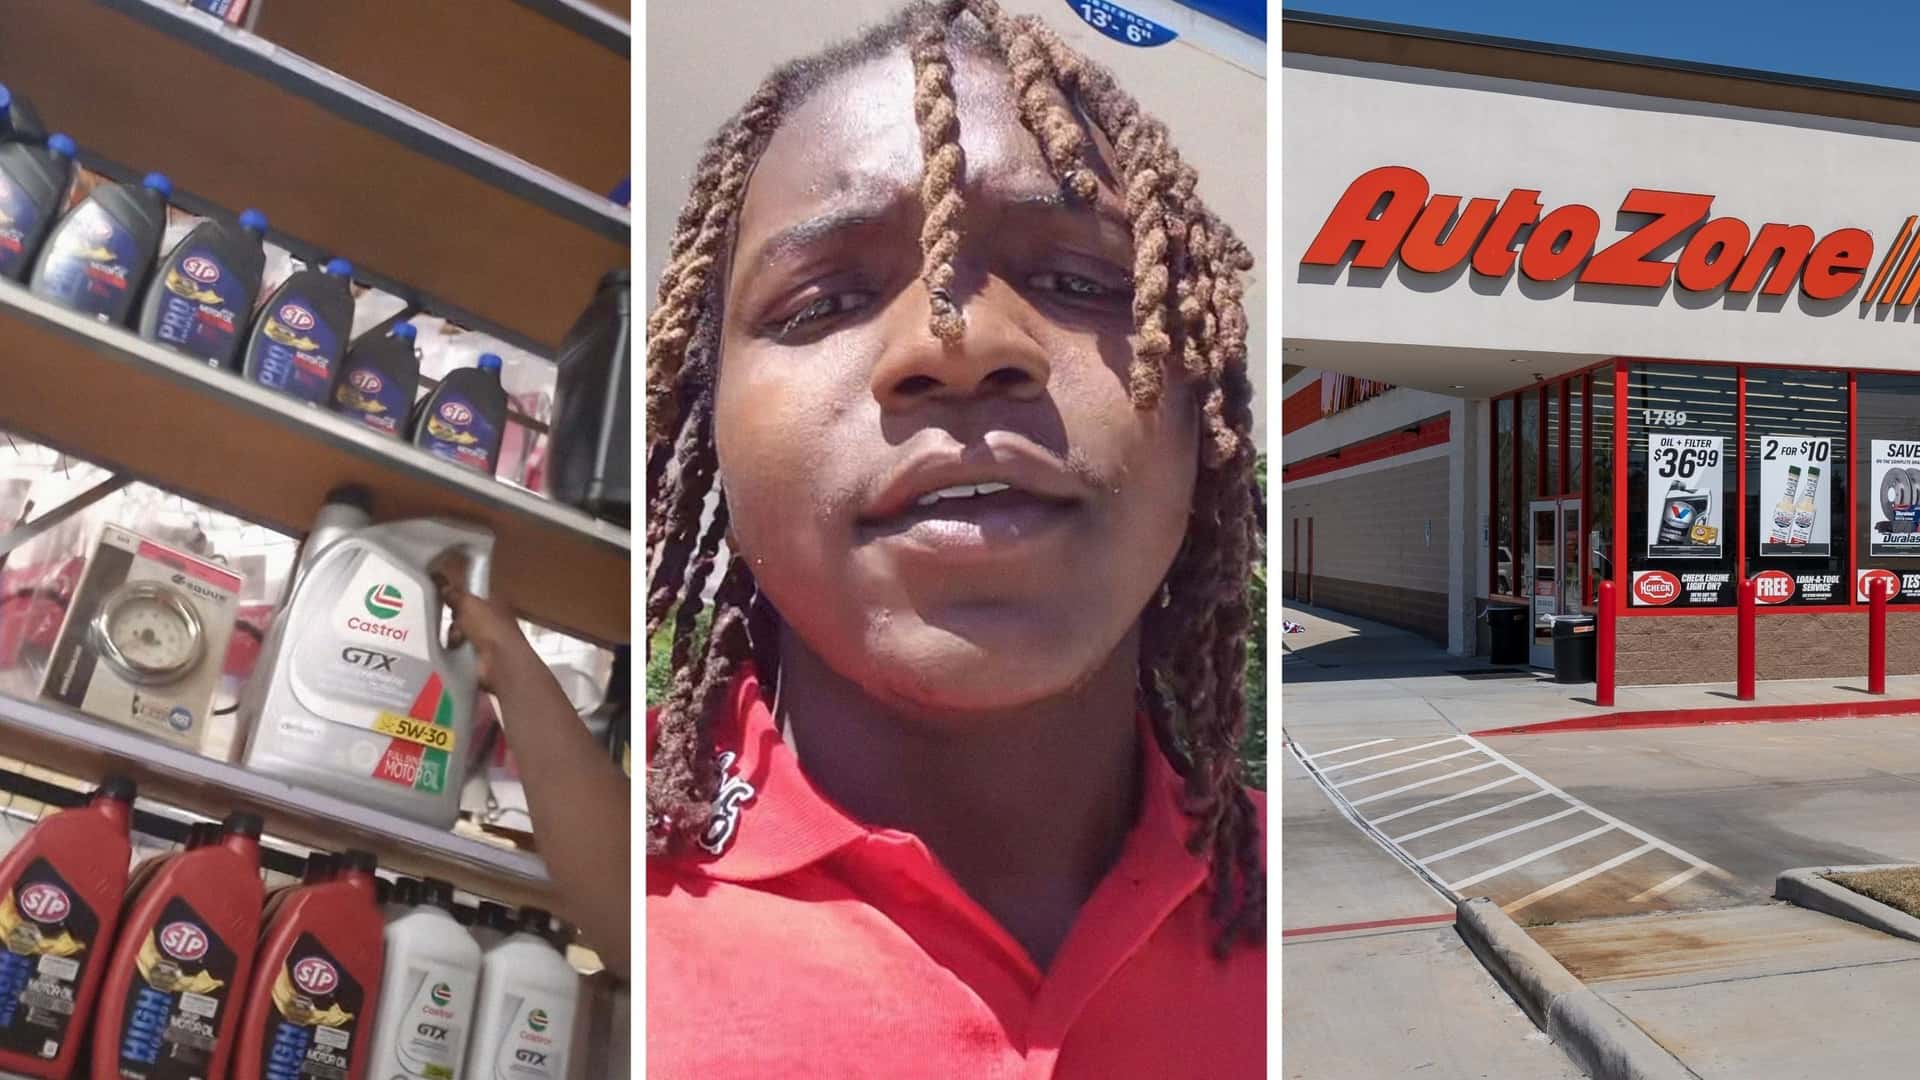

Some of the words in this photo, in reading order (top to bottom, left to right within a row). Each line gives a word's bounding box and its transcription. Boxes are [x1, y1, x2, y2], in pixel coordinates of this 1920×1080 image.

[1300, 165, 1875, 300] AutoZone
[187, 260, 216, 278] STP
[284, 307, 311, 325] STP
[354, 373, 379, 390] STP
[443, 405, 469, 421] STP
[1642, 410, 1687, 426] 1789
[1660, 438, 1674, 447] OIL
[1684, 438, 1712, 448] FILTER
[1763, 440, 1779, 461] 2
[1781, 446, 1797, 456] FOR
[1800, 441, 1830, 462] $10
[1887, 443, 1920, 458] SAVE
[1681, 573, 1705, 582] CHECK
[1705, 574, 1730, 583] ENGINE
[1686, 582, 1706, 591] LIGHT
[1706, 582, 1722, 591] ON?
[1757, 577, 1788, 597] FREE
[1796, 575, 1840, 584] LOAN-A-TOOL
[1864, 576, 1894, 595] FE
[1647, 584, 1671, 592] CHECK
[1802, 583, 1833, 592] SERVICE
[347, 616, 409, 642] Castrol
[342, 647, 397, 673] GTX
[395, 720, 448, 746] 5W-30
[384, 760, 423, 782] MOTOR
[24, 886, 65, 914] STP
[164, 924, 202, 952] STP
[298, 960, 332, 987] STP
[121, 987, 163, 1061] HIGH
[417, 1023, 448, 1041] GTX
[515, 1048, 547, 1066] GTX
